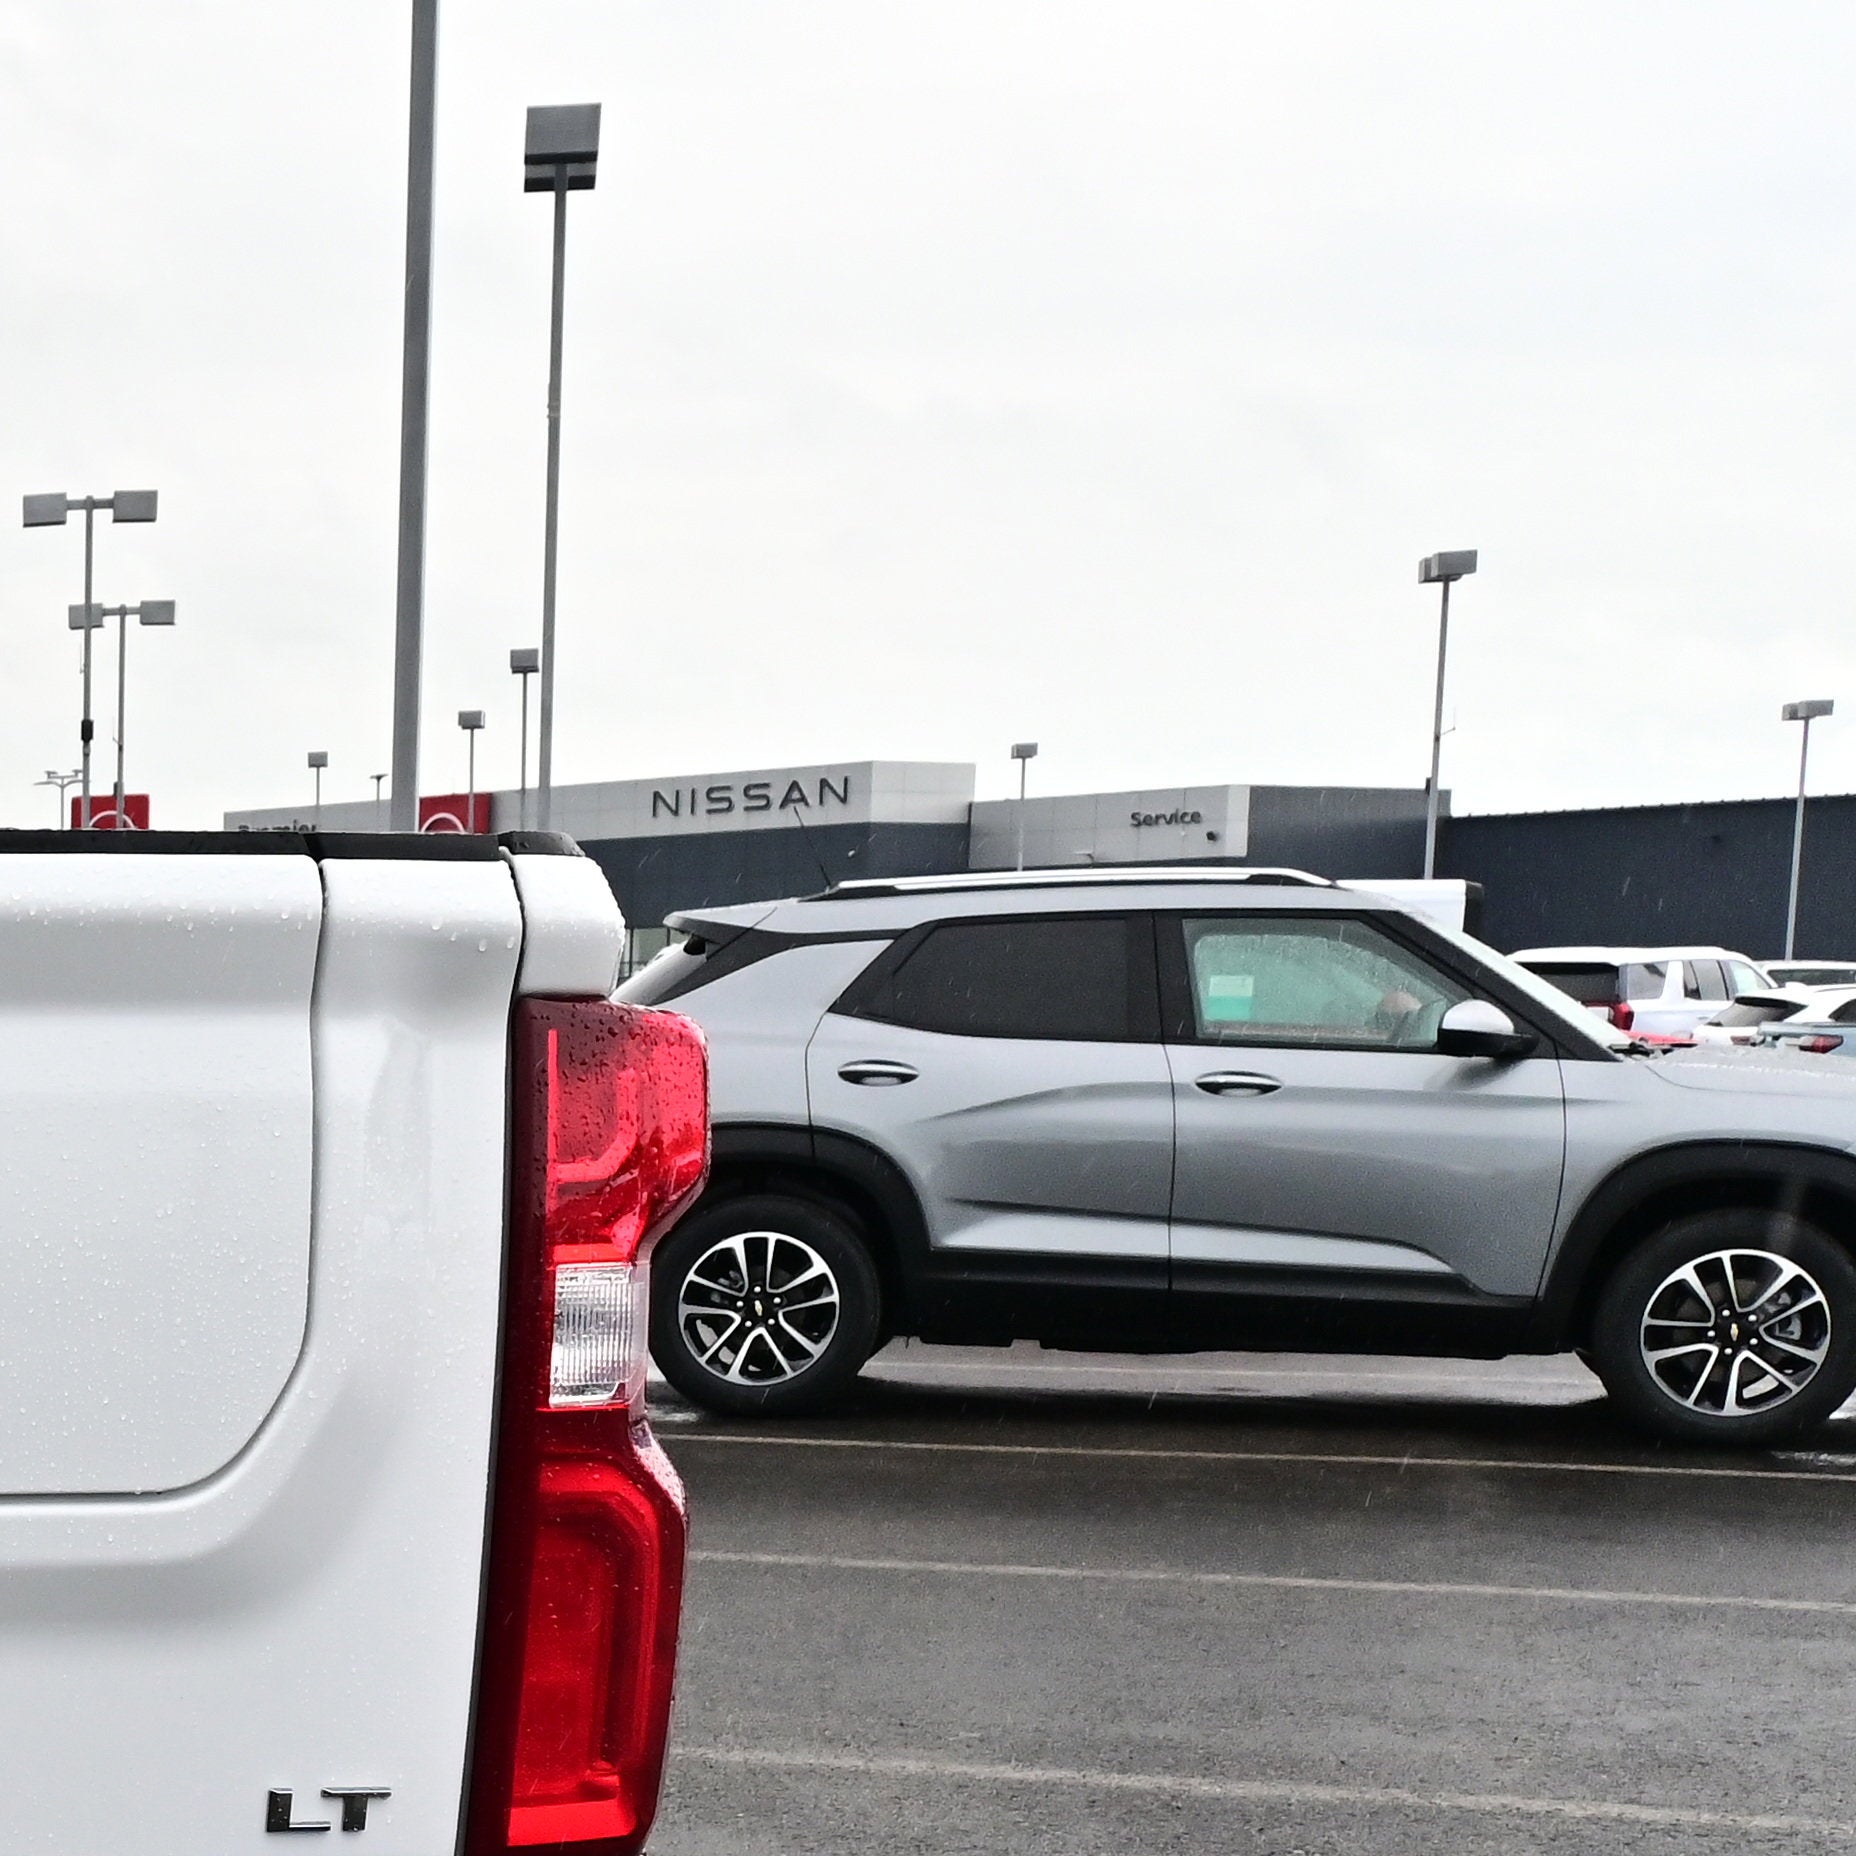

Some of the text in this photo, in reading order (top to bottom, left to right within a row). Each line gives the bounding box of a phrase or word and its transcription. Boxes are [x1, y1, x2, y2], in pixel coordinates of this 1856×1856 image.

[652, 776, 849, 818] NISSAN
[1130, 808, 1202, 827] Service
[266, 1787, 392, 1833] LT
